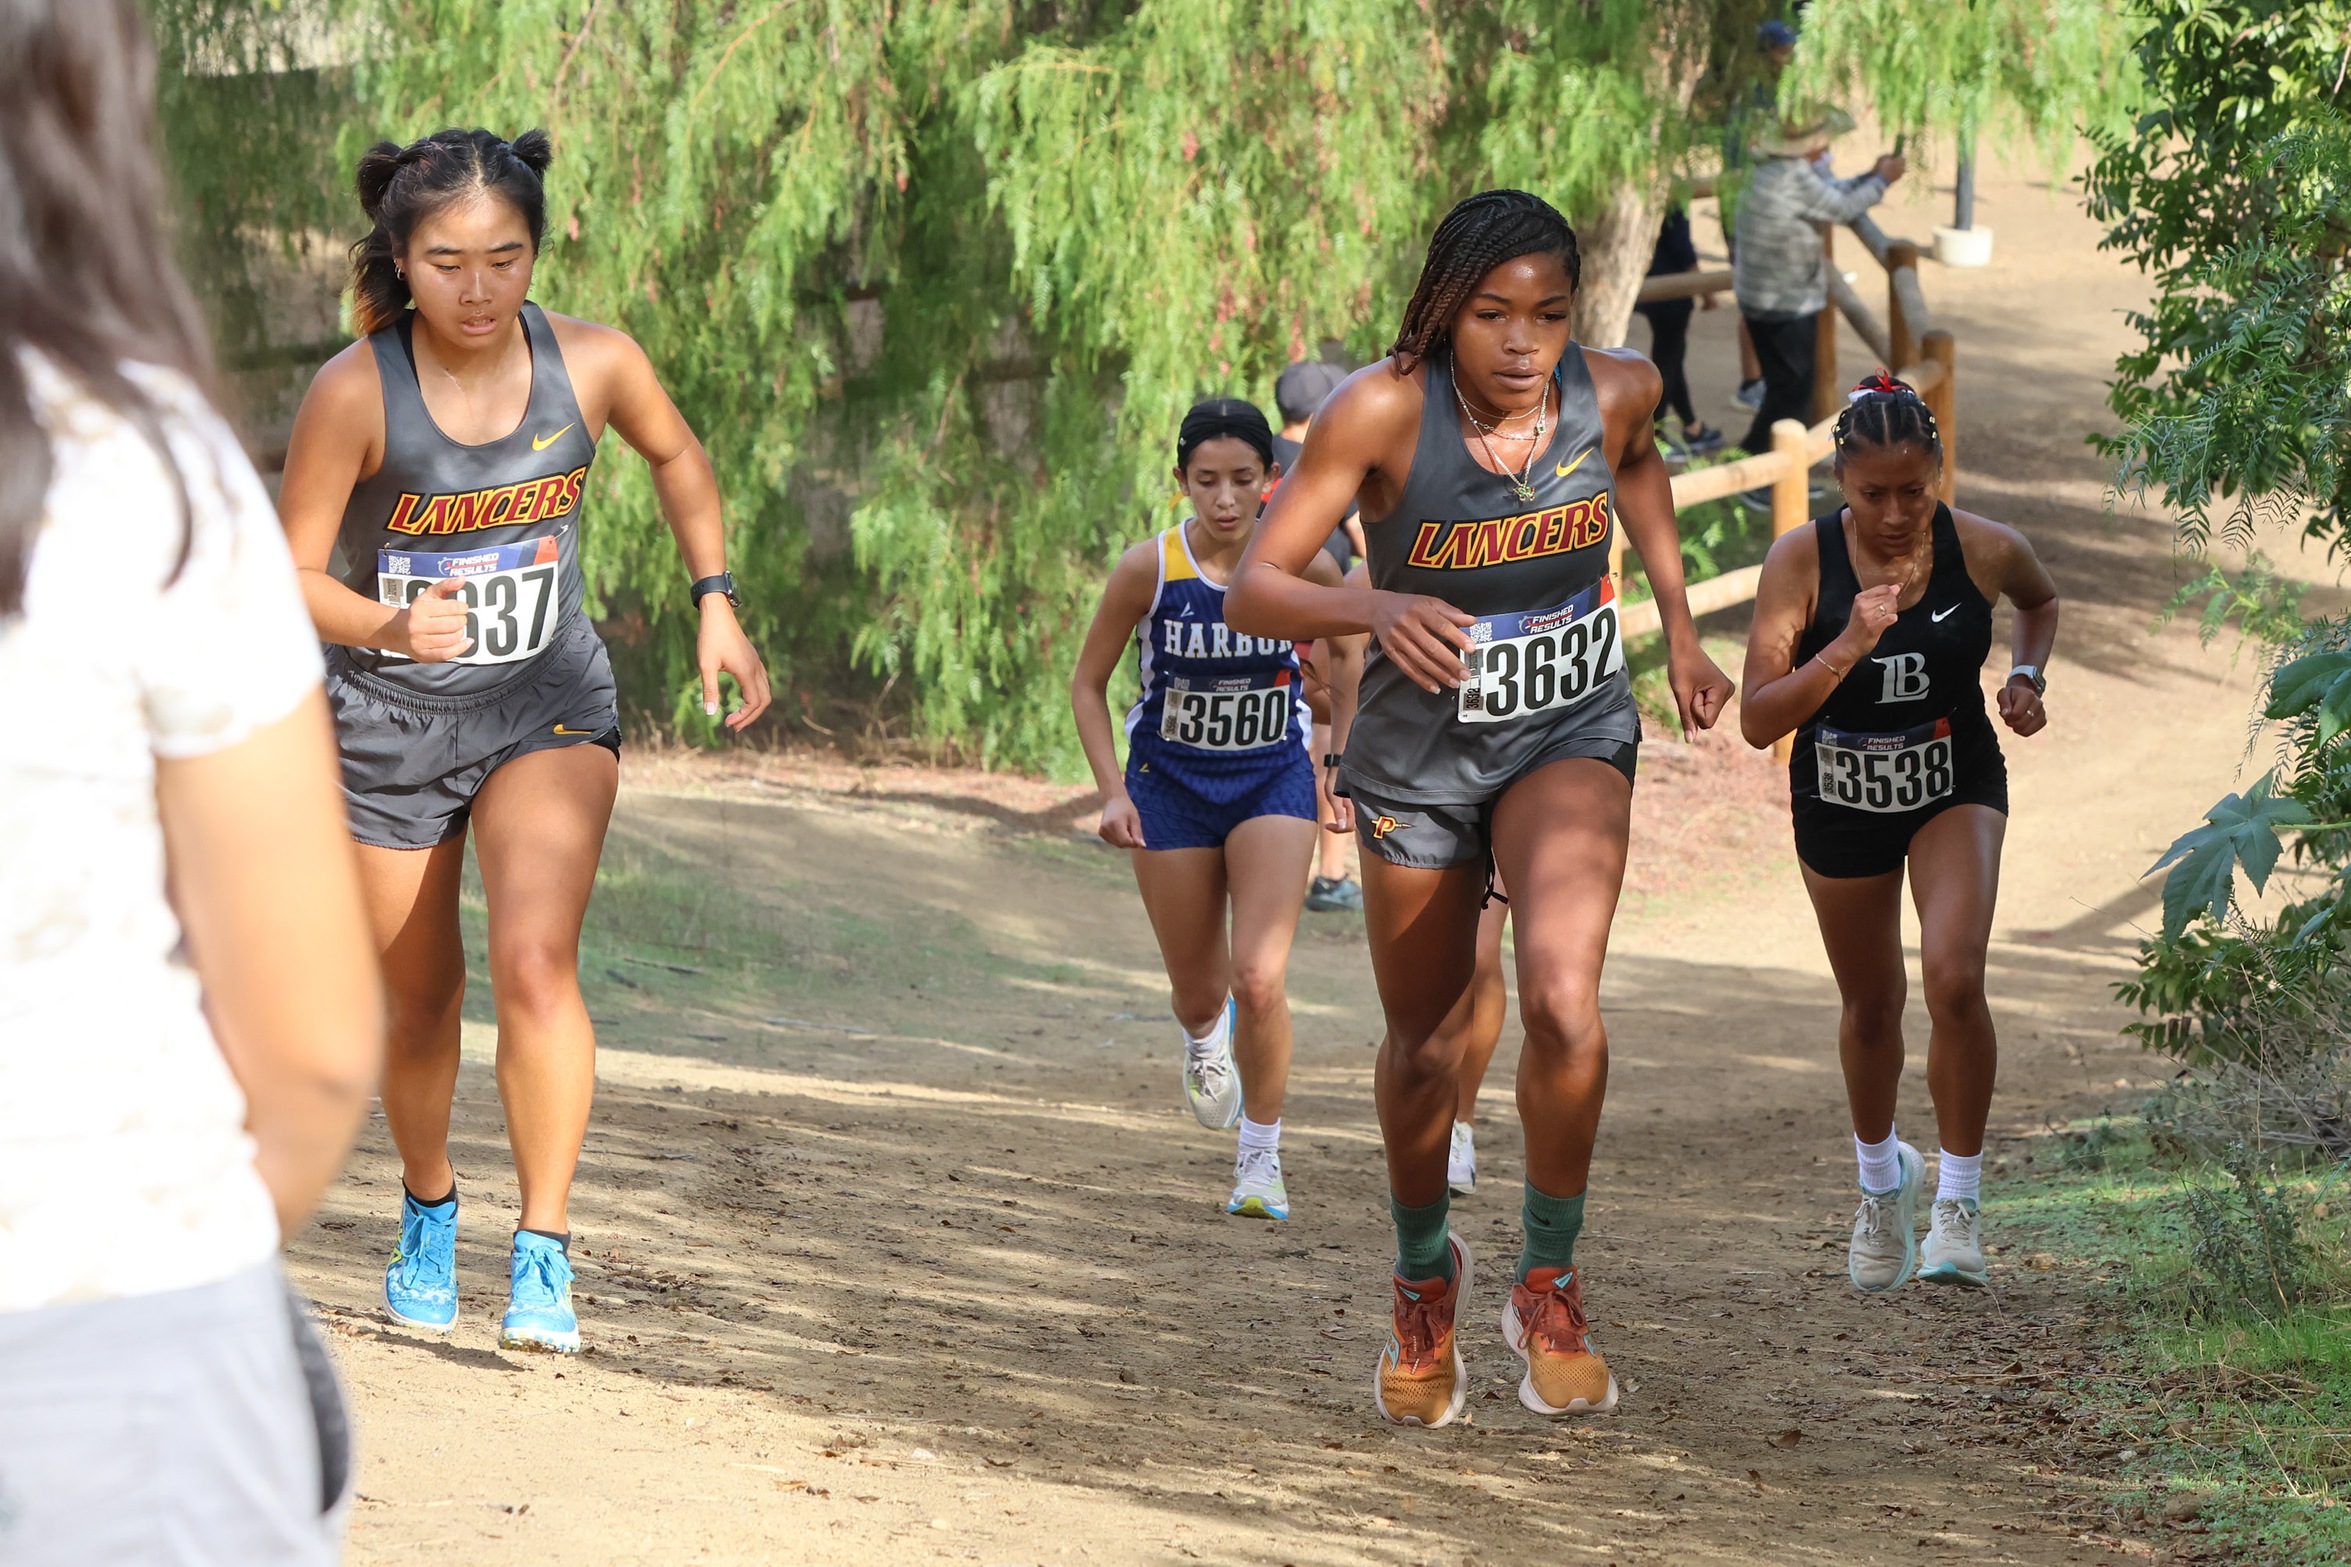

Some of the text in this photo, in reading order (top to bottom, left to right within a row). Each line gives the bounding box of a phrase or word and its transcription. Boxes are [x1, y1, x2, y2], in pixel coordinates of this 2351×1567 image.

[387, 467, 586, 534] LANCERS
[1408, 492, 1608, 569] LANCERS
[450, 563, 496, 577] RESULTS
[452, 553, 499, 567] FINISHED
[1530, 614, 1573, 634] RESULTS
[1532, 604, 1574, 624] FINISHED
[1486, 607, 1618, 716] 3632
[1871, 652, 1930, 704] LB
[1180, 690, 1286, 746] 3560
[1866, 743, 1904, 751] RESULTS
[1868, 735, 1906, 745] FINISHED
[1836, 742, 1949, 808] 3538
